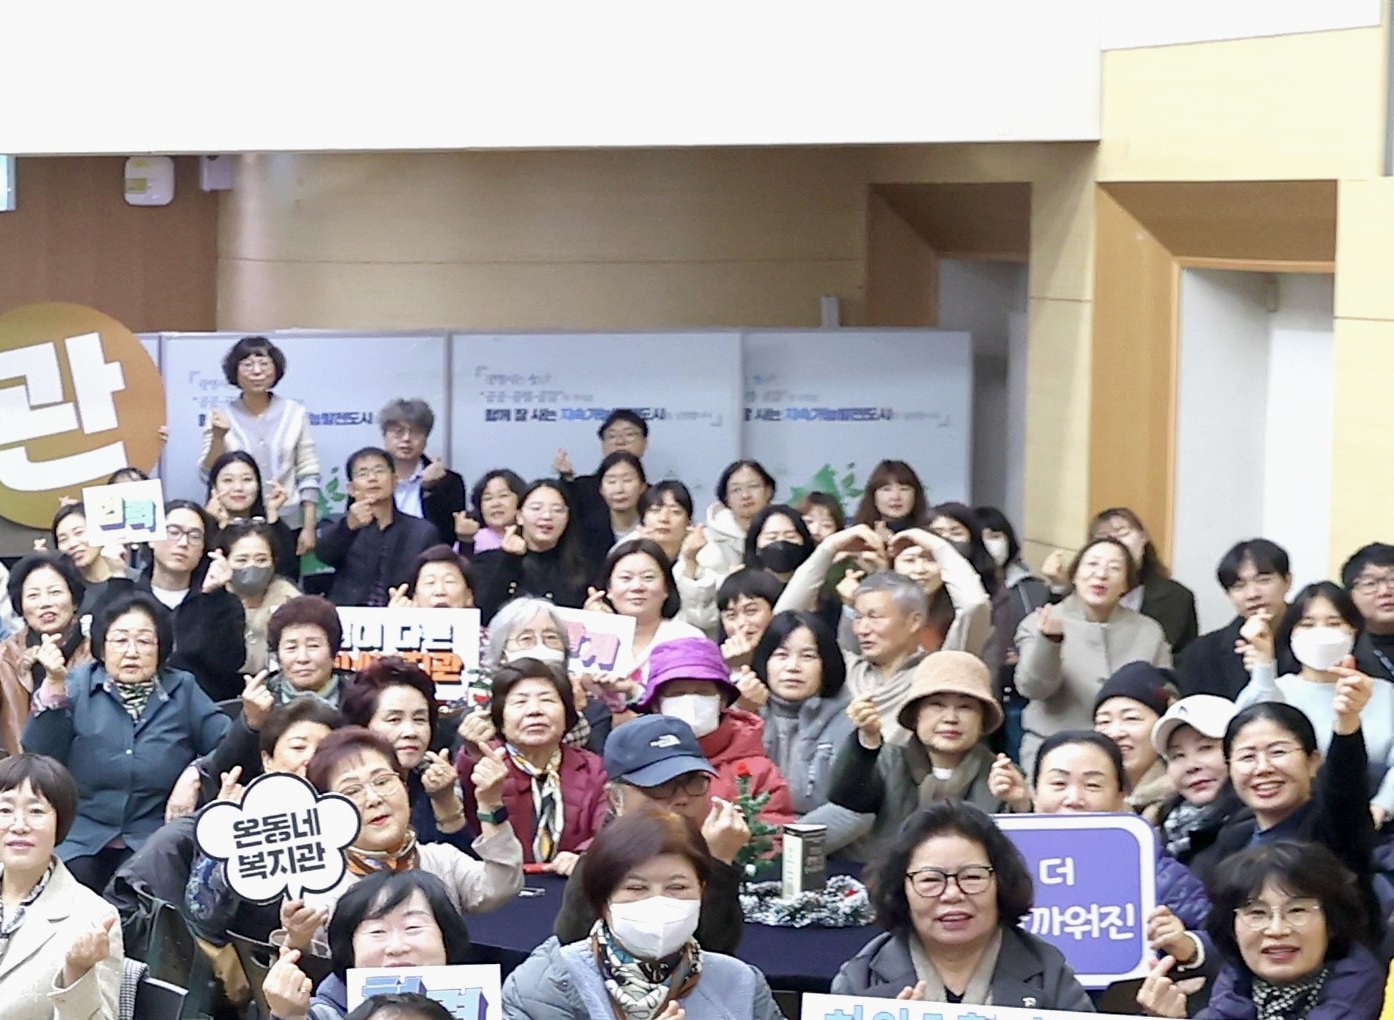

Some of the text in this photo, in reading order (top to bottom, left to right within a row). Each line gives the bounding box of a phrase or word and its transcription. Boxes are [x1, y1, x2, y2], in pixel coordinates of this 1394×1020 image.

[308, 412, 373, 425] 능발전도시
[232, 811, 322, 844] 온동네
[238, 847, 326, 881] 복지관
[1038, 856, 1076, 887] 더
